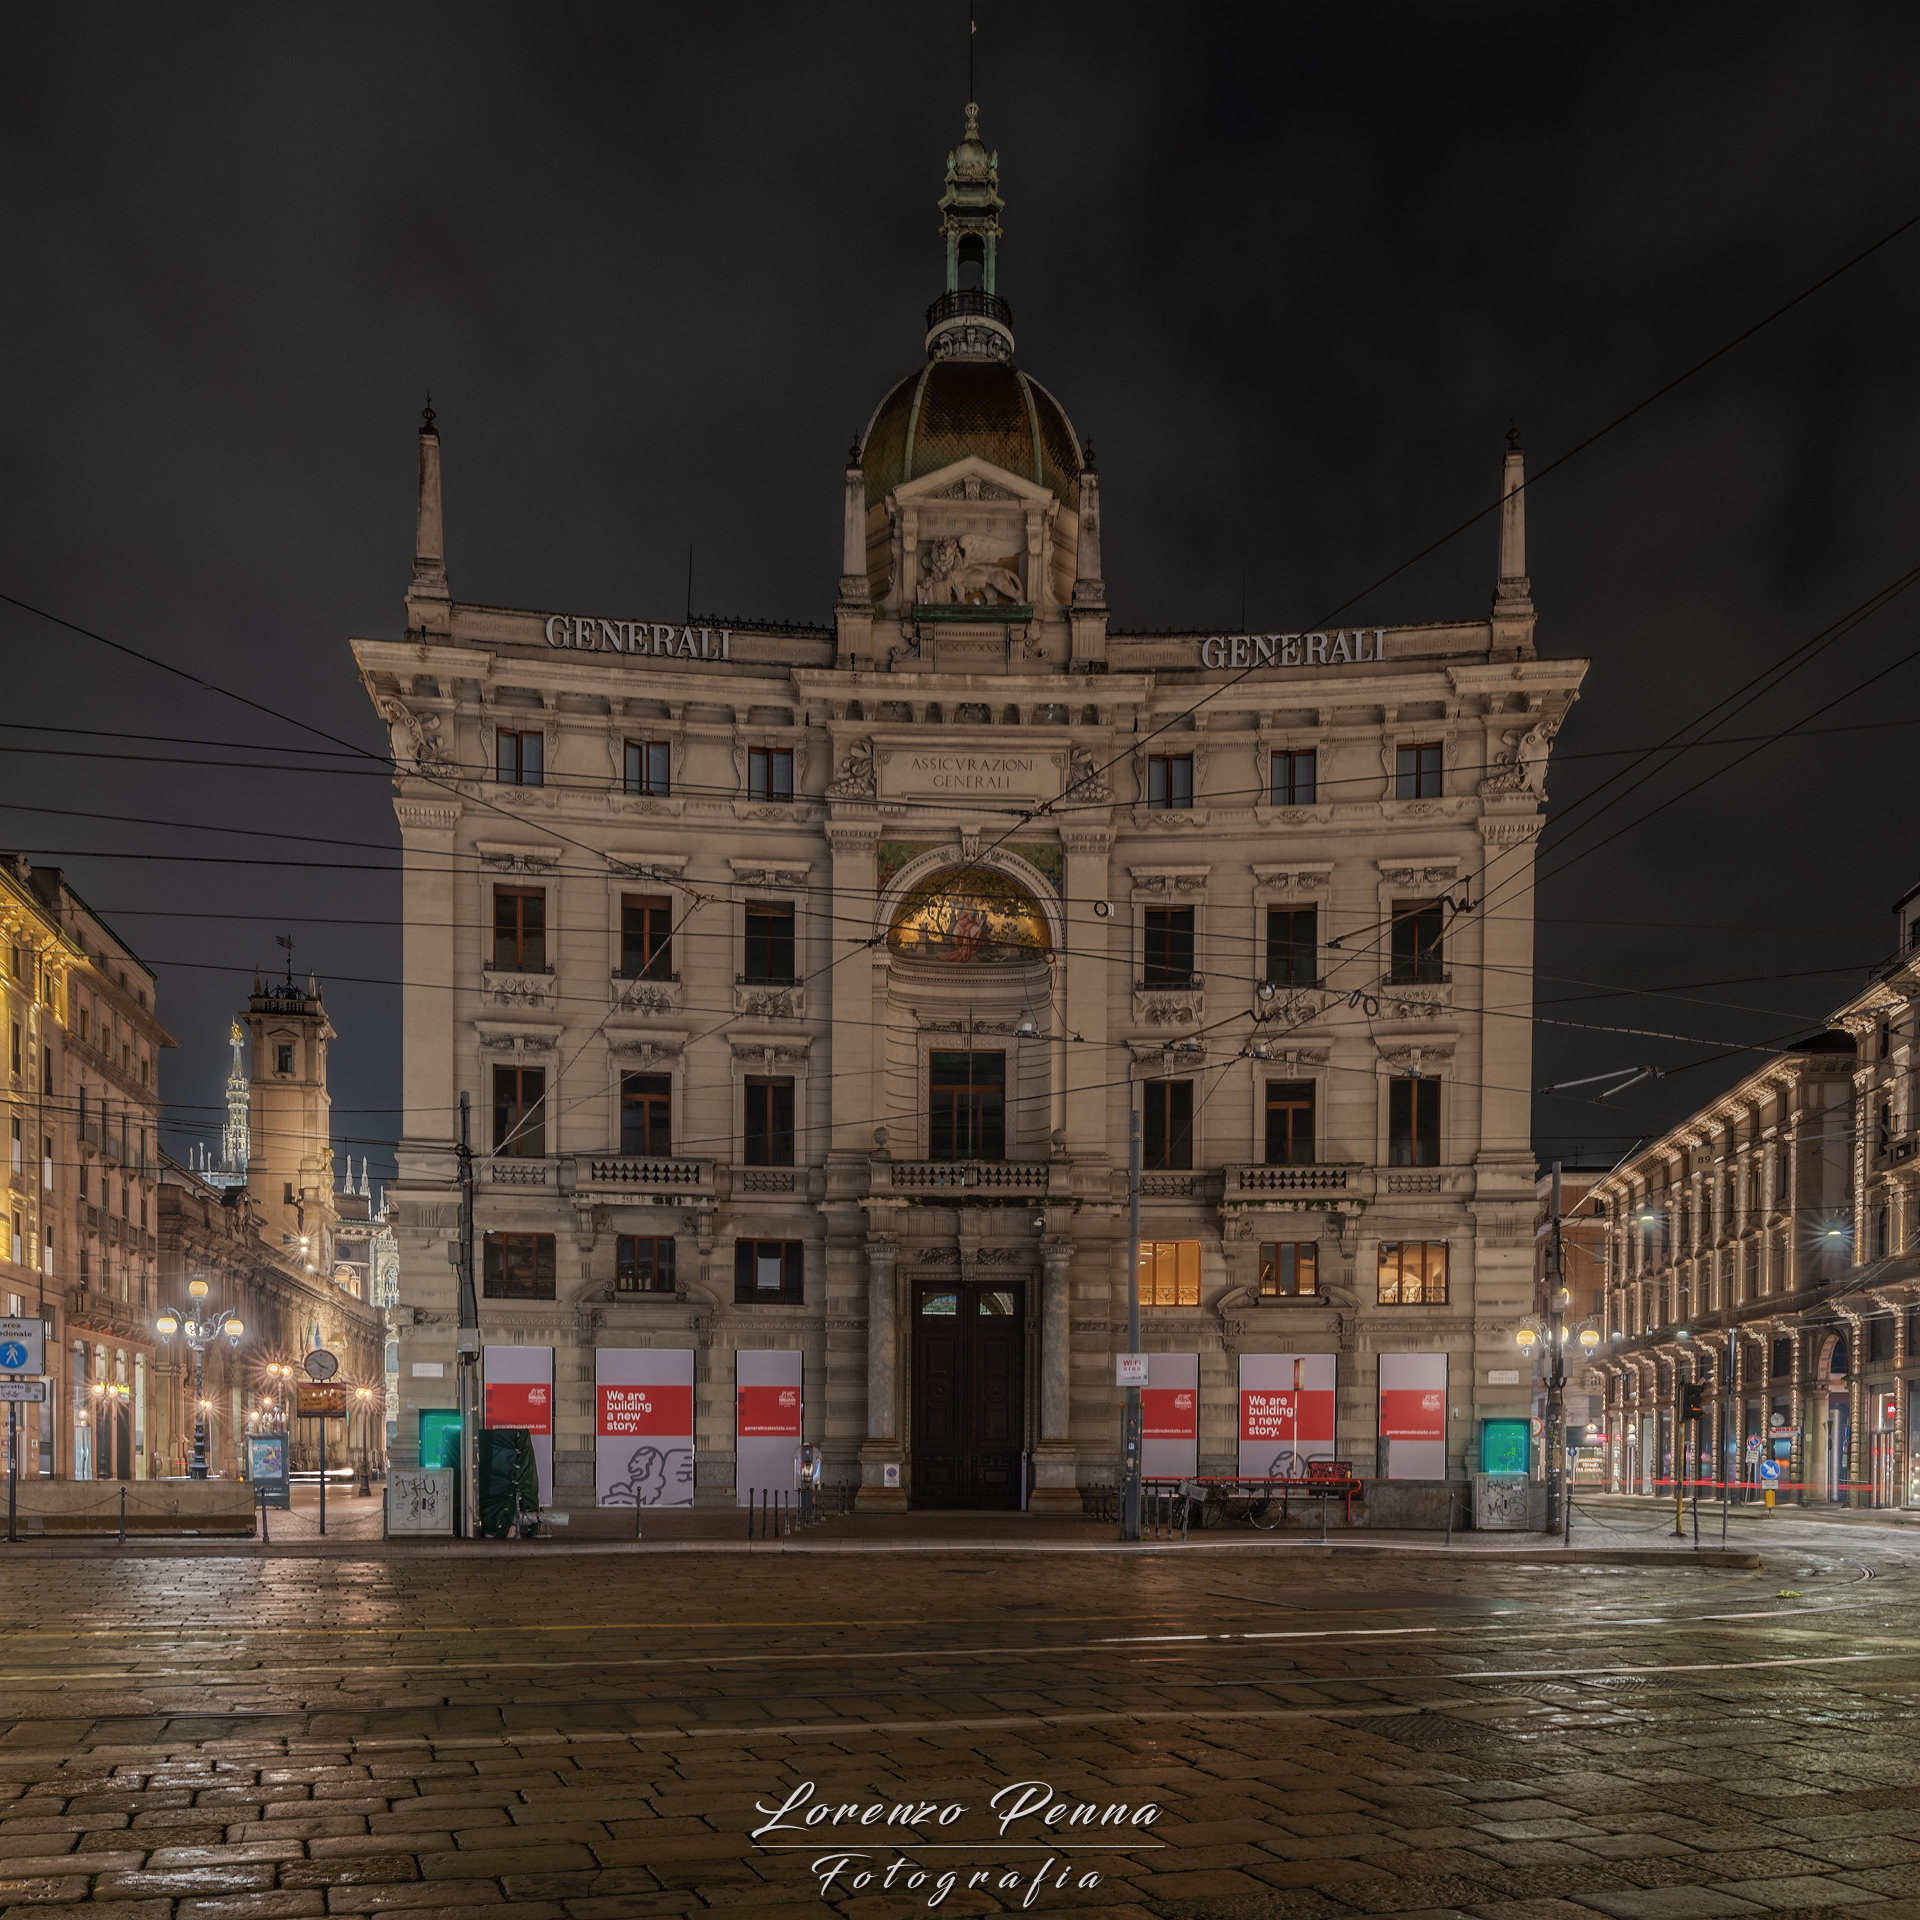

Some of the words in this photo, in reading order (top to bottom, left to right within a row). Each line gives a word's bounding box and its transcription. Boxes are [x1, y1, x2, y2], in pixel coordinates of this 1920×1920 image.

[545, 614, 733, 661] GENERALI
[1201, 629, 1387, 669] GENERALI
[933, 774, 1010, 788] GENERALI
[1698, 1155, 1710, 1164] 89
[606, 1390, 625, 1401] We
[627, 1392, 646, 1401] are
[1248, 1395, 1266, 1406] We
[1269, 1397, 1287, 1406] are
[606, 1400, 652, 1413] building
[1248, 1405, 1293, 1418] building
[607, 1412, 614, 1421] a
[617, 1412, 641, 1421] new
[1249, 1416, 1256, 1425] a
[1259, 1416, 1282, 1425] new
[606, 1420, 638, 1432] story.
[1248, 1425, 1279, 1437] story.
